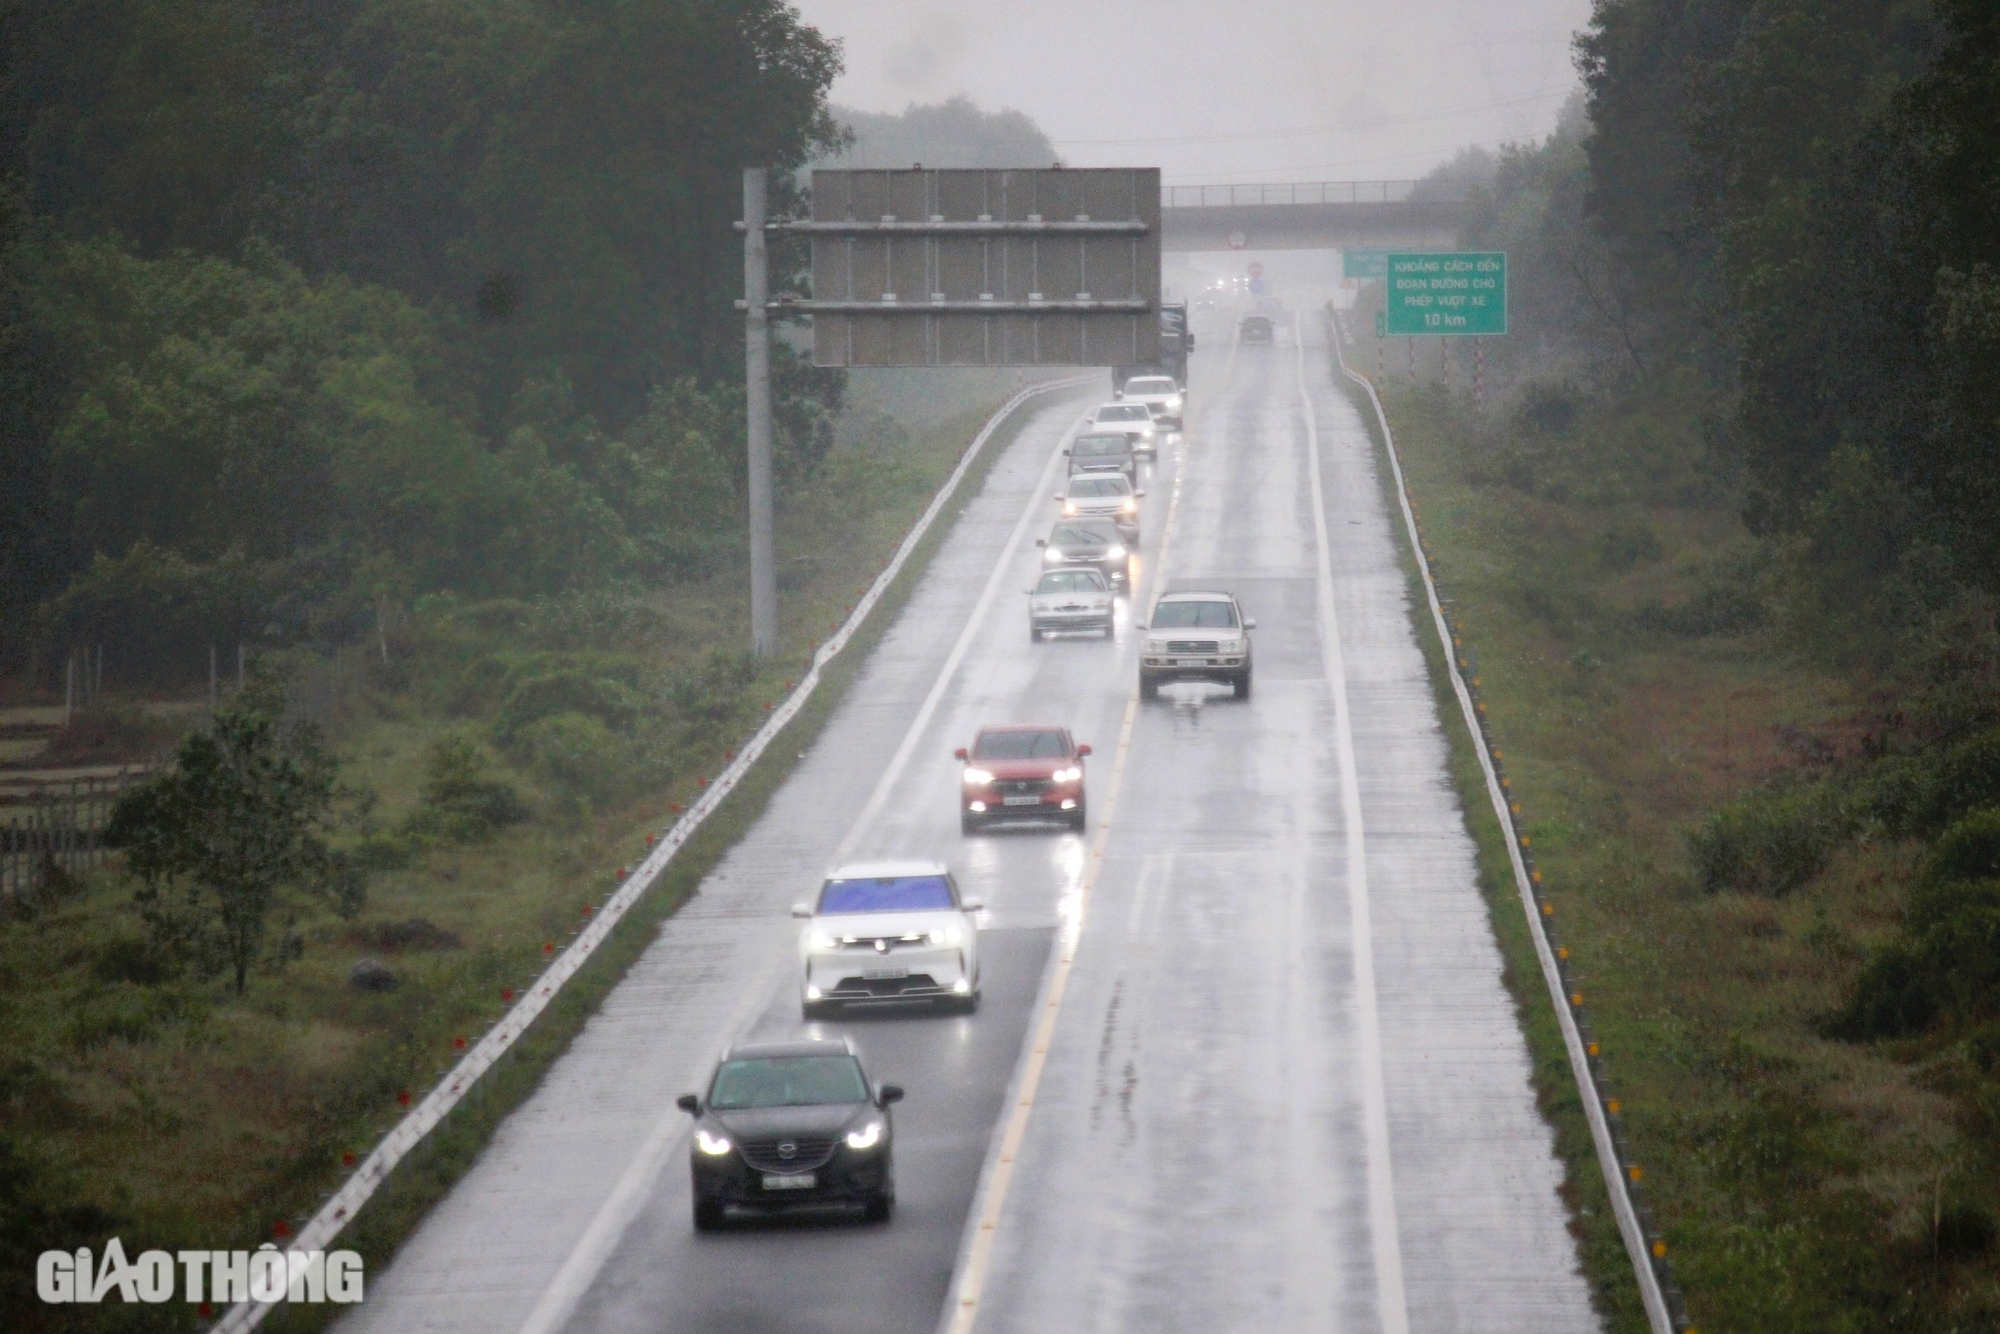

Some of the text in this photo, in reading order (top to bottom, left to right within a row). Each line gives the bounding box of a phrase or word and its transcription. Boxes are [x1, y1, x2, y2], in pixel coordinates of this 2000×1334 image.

[1444, 259, 1473, 272] CÁCH
[1473, 278, 1495, 289] CHO
[1405, 293, 1433, 306] PHÉP
[1471, 295, 1486, 306] XE
[1444, 313, 1466, 326] km
